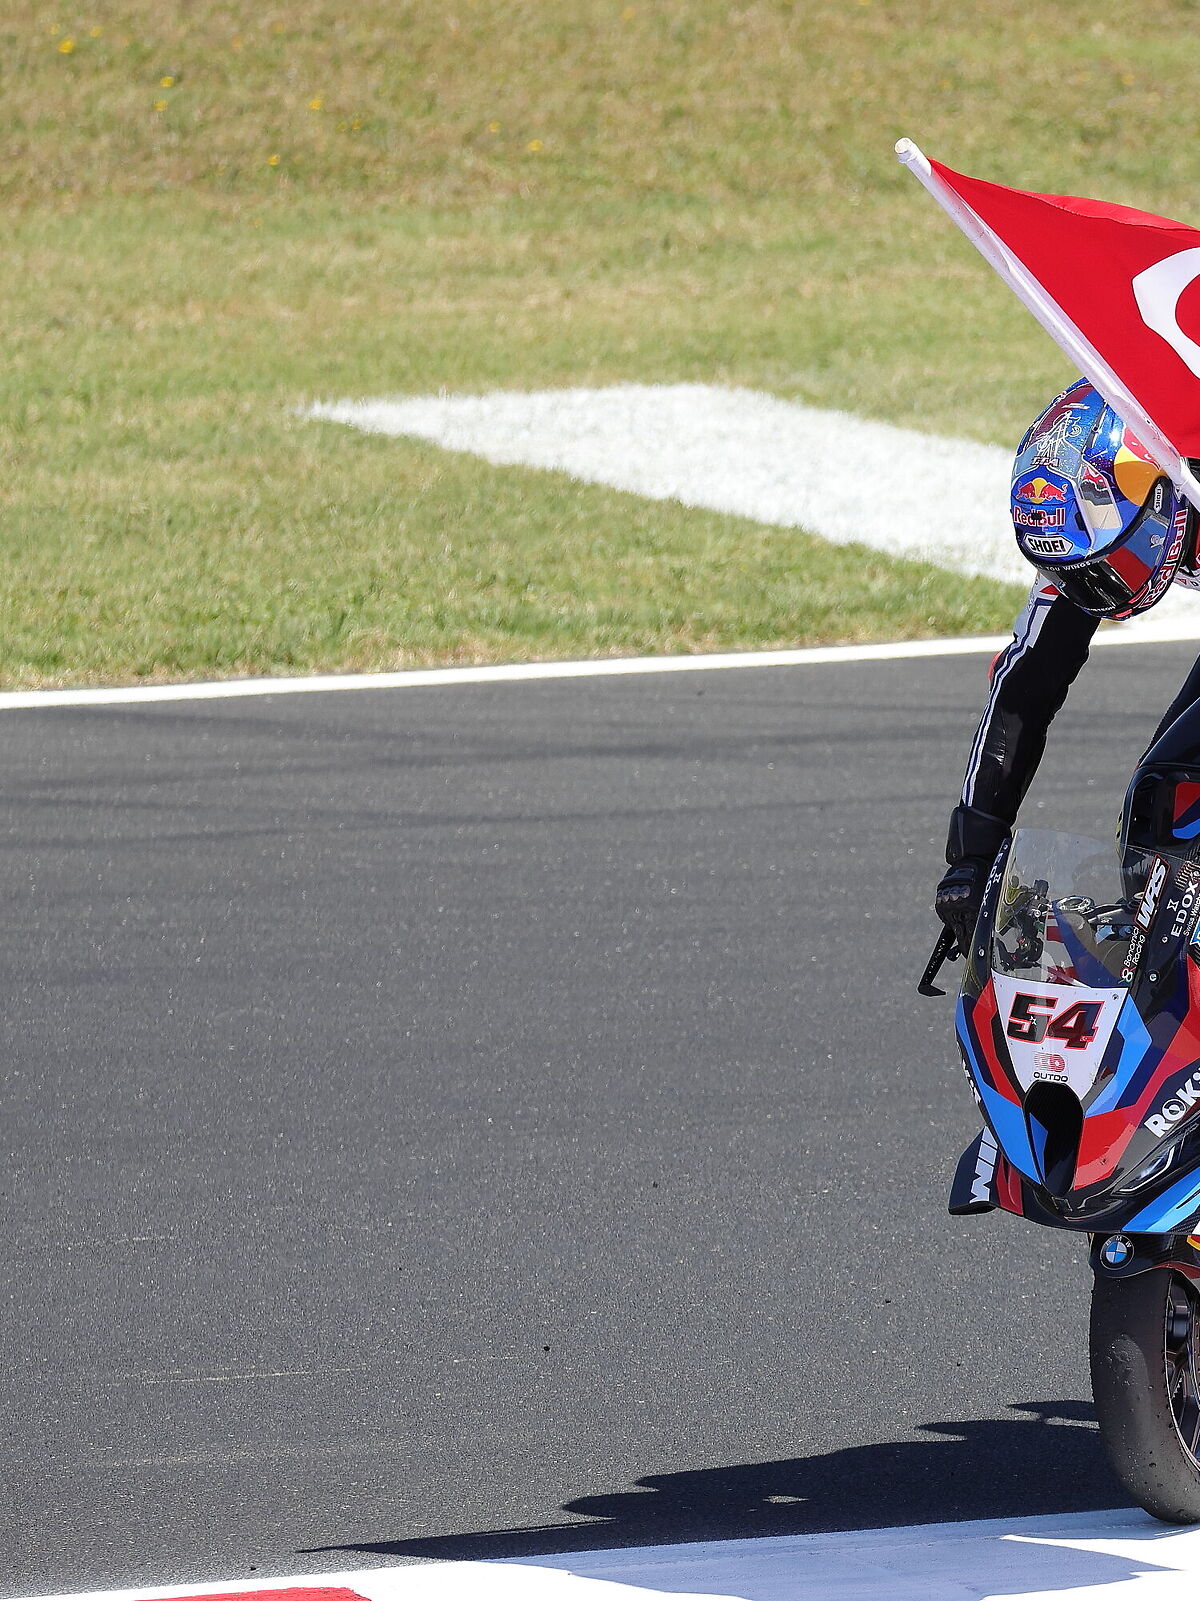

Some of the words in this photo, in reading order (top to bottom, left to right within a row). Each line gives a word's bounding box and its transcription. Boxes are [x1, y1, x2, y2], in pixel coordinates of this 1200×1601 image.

[1013, 506, 1037, 526] Red
[1036, 507, 1066, 527] Bull
[1167, 508, 1189, 561] Bull
[1028, 537, 1066, 553] SHOEI
[1137, 858, 1167, 929] WRS
[1170, 881, 1199, 938] EDOX
[1183, 916, 1195, 937] Swiss
[1123, 926, 1140, 967] Bonamici
[1132, 934, 1146, 966] Racing
[1006, 991, 1105, 1051] 54
[1033, 1071, 1069, 1083] OUTDO
